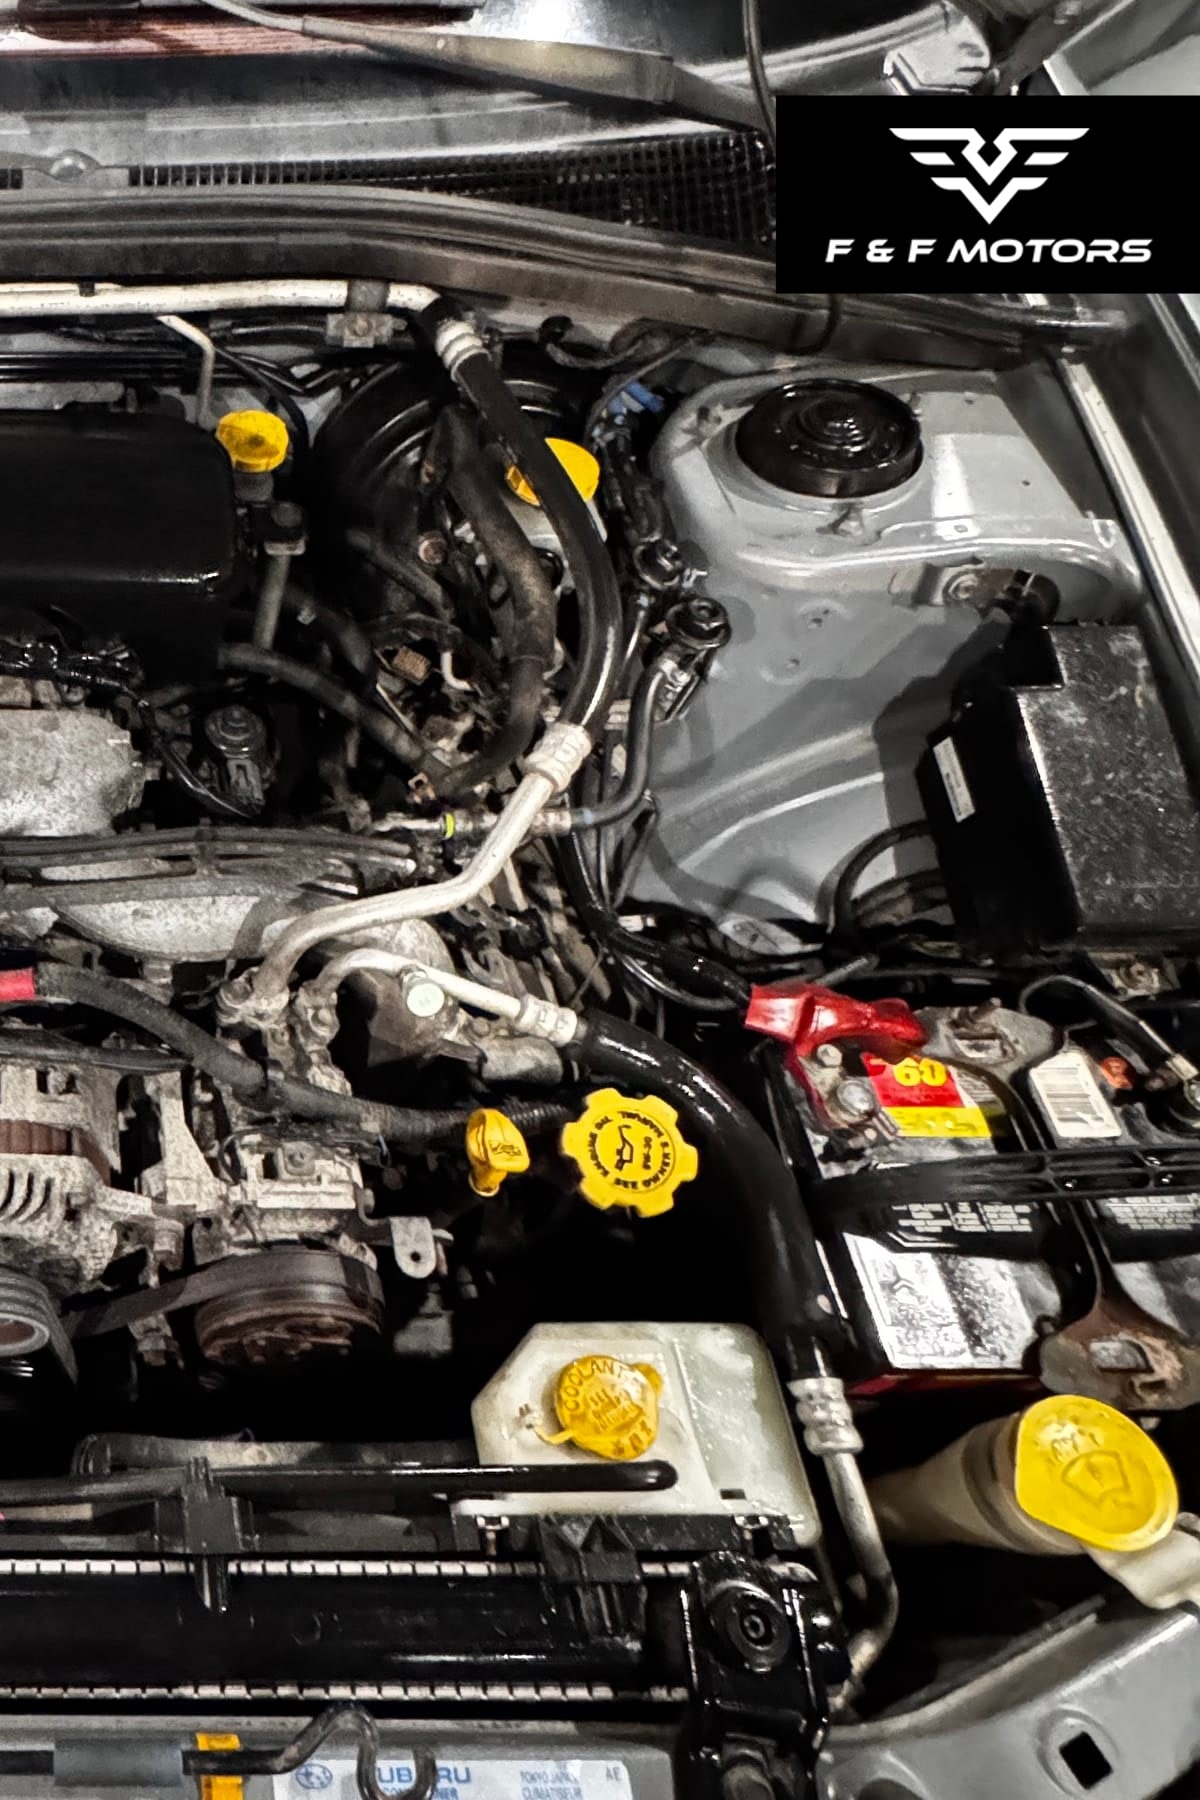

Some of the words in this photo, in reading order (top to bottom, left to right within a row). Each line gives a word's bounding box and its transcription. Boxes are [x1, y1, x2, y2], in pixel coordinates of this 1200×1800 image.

[893, 1057, 947, 1087] 60
[563, 1359, 627, 1412] COOLANT
[376, 1766, 472, 1784] UBRU
